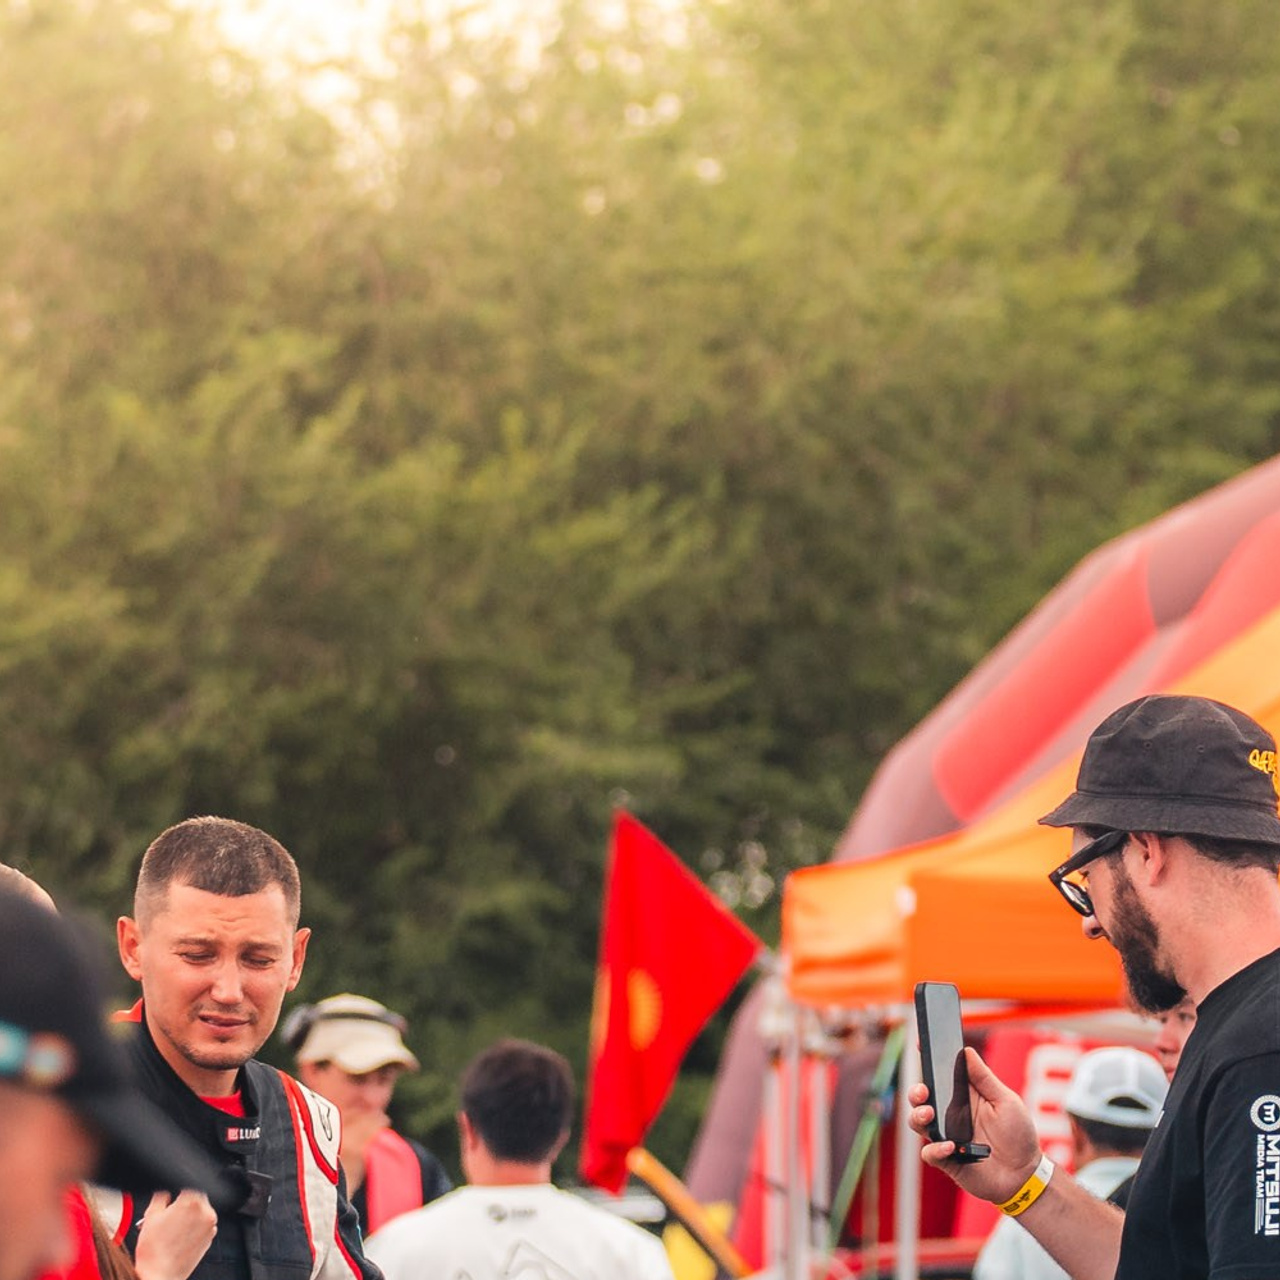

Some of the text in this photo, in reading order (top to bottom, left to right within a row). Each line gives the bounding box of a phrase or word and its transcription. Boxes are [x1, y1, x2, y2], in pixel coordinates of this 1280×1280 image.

[1255, 1134, 1266, 1199] MEDIA TEAM
[1264, 1134, 1280, 1236] MITSUJI
